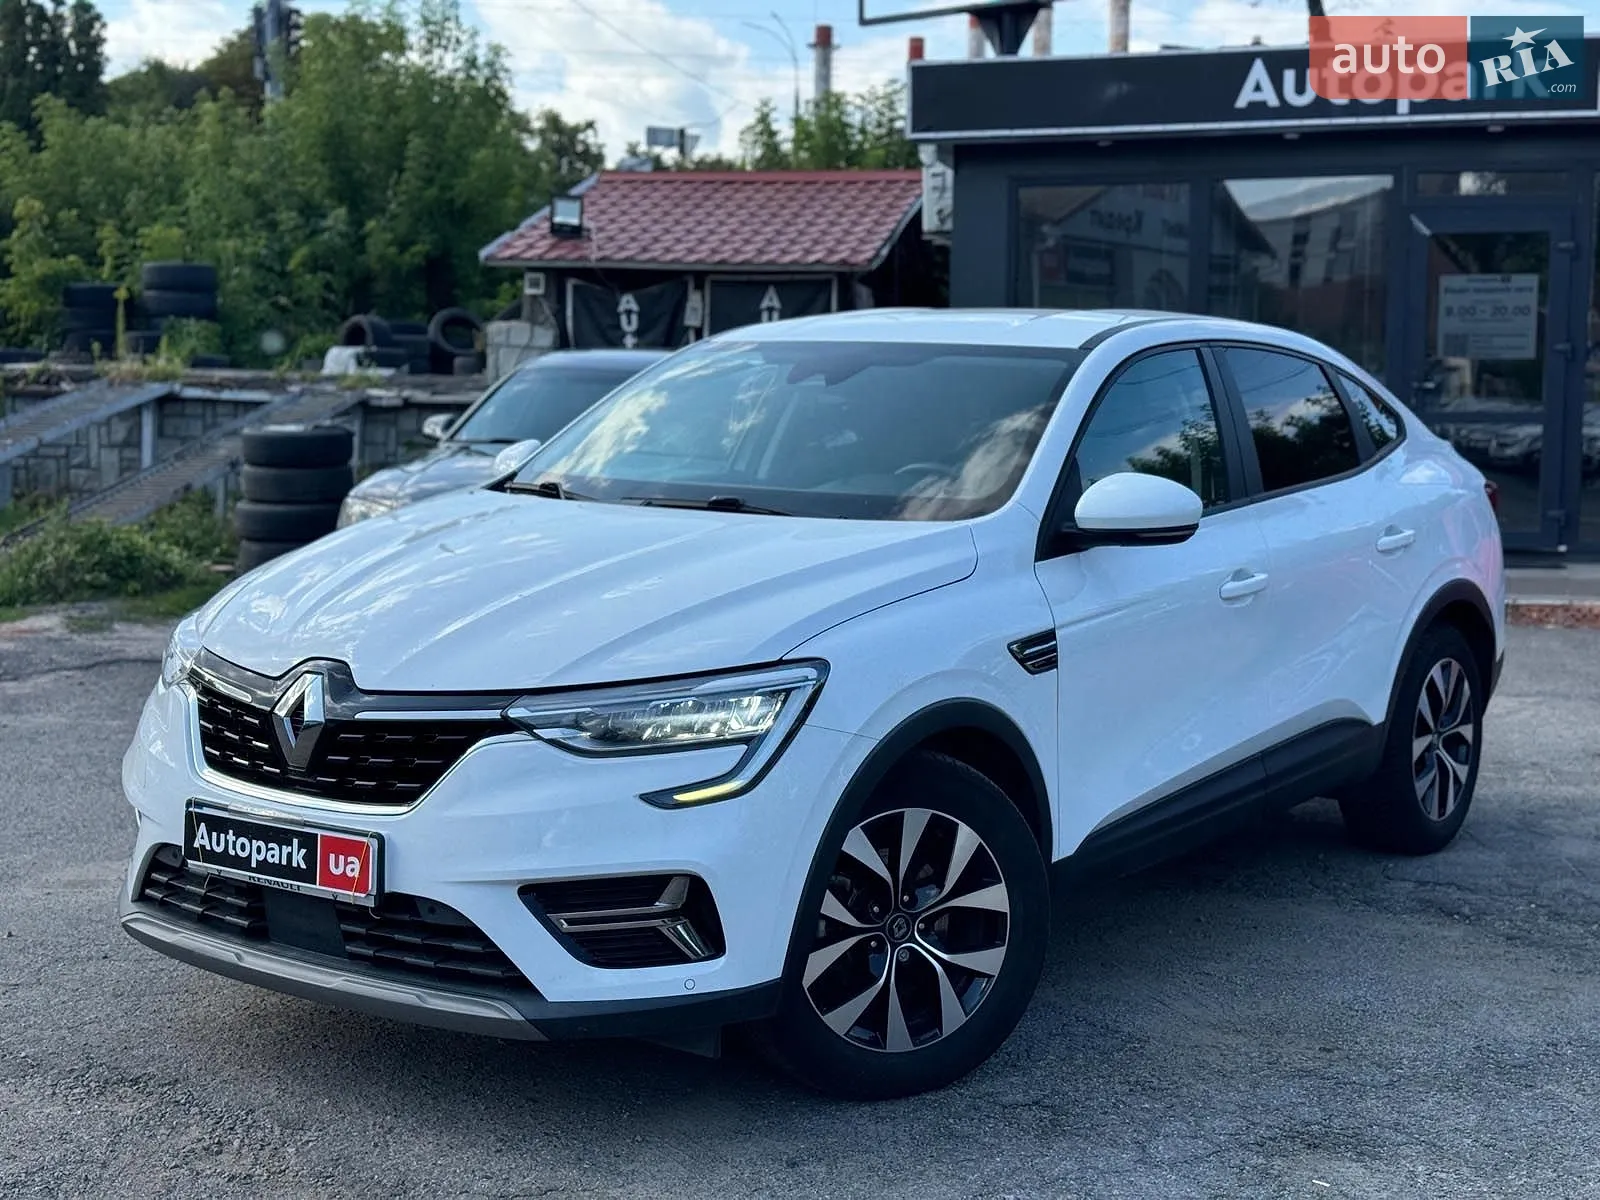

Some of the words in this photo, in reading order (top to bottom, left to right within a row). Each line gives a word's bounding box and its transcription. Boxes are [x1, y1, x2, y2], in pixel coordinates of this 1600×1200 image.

[1234, 57, 1550, 115] Autopark
[193, 822, 308, 869] Autopark
[329, 853, 360, 878] ua
[247, 875, 302, 892] RENAULT
